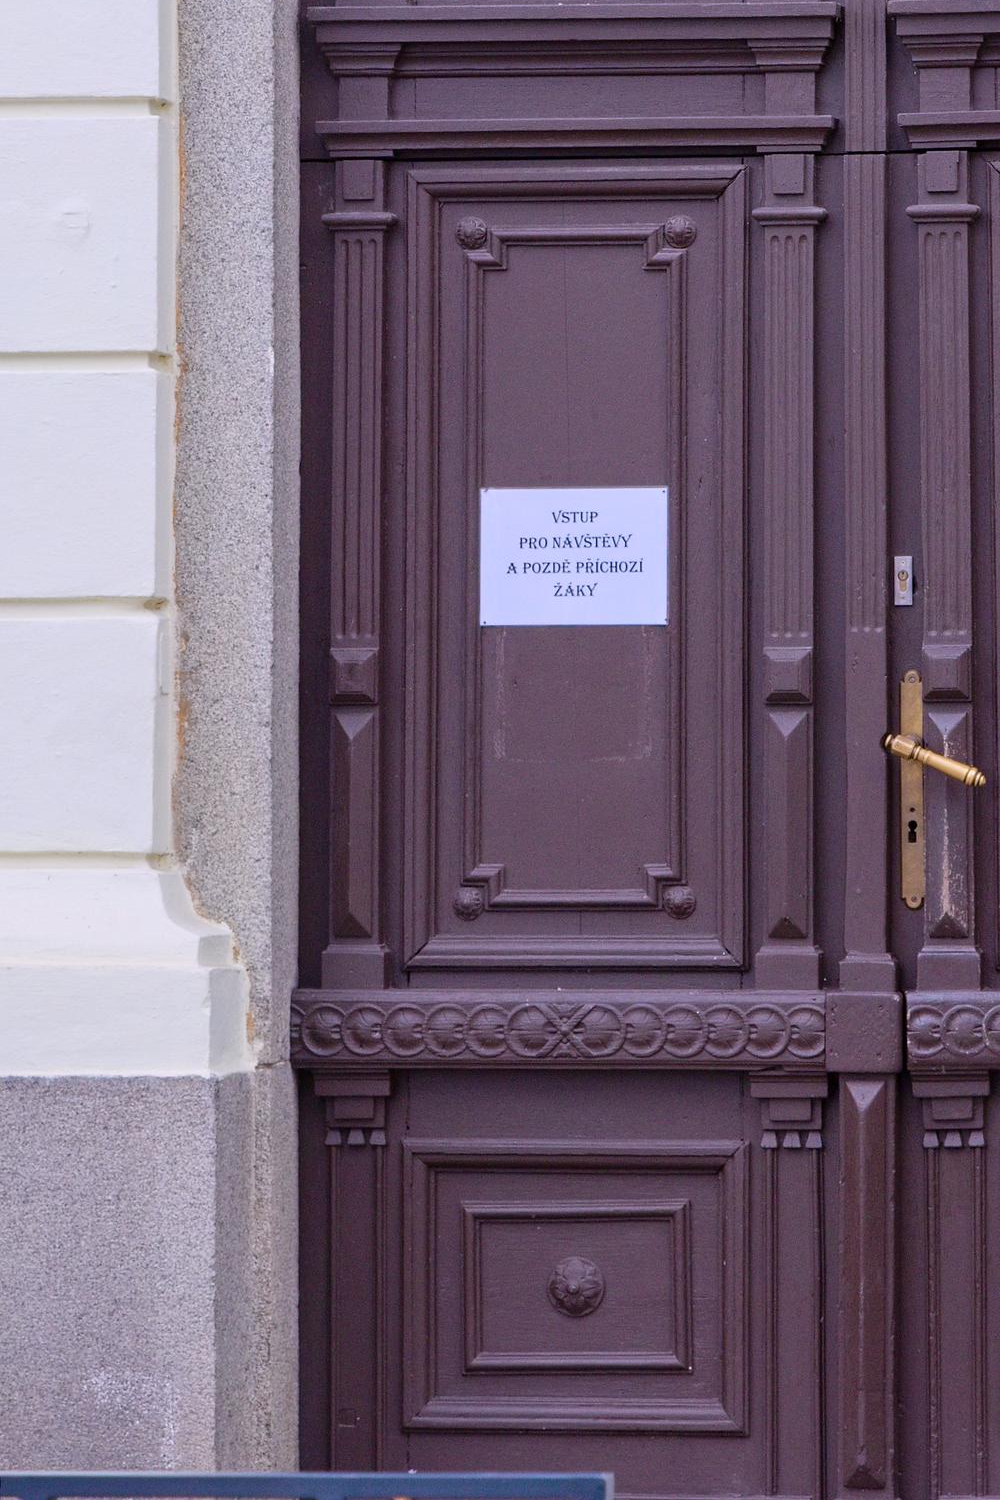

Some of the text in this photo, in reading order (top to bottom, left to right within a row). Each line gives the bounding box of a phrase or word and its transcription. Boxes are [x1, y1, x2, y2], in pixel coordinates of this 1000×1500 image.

[552, 510, 599, 524] VSTUP
[519, 533, 632, 549] PRO NÁVŠTĚVY
[506, 557, 644, 574] A POZDĚ PŘÍCHOZÍ
[553, 582, 598, 597] ŽÁKY
